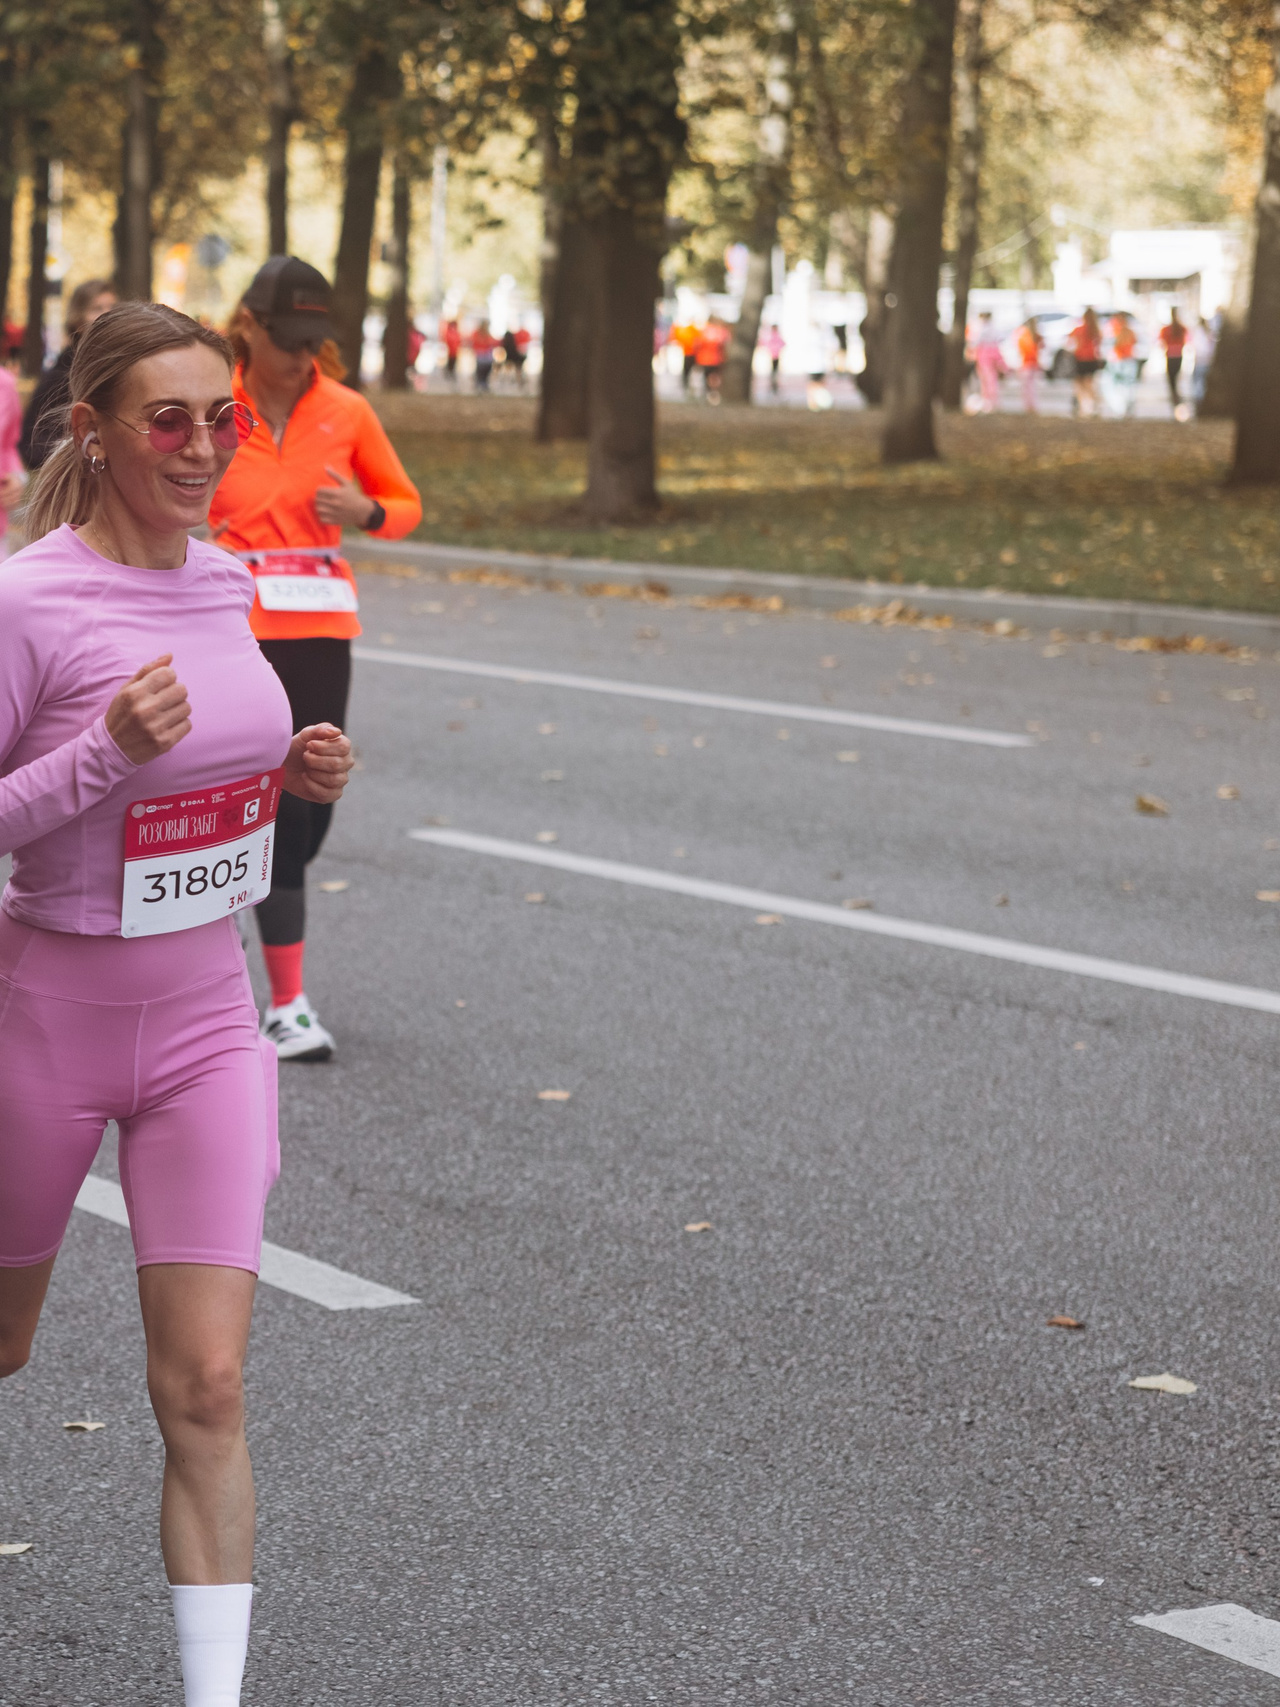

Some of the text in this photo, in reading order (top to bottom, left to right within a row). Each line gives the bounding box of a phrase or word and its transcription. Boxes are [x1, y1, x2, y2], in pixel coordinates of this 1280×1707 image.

[246, 800, 258, 818] C
[138, 811, 220, 846] РОЗОВЫЙ ЗАБЕГ
[261, 835, 271, 881] МОСКВА
[142, 849, 250, 904] 31805
[228, 896, 235, 909] 3
